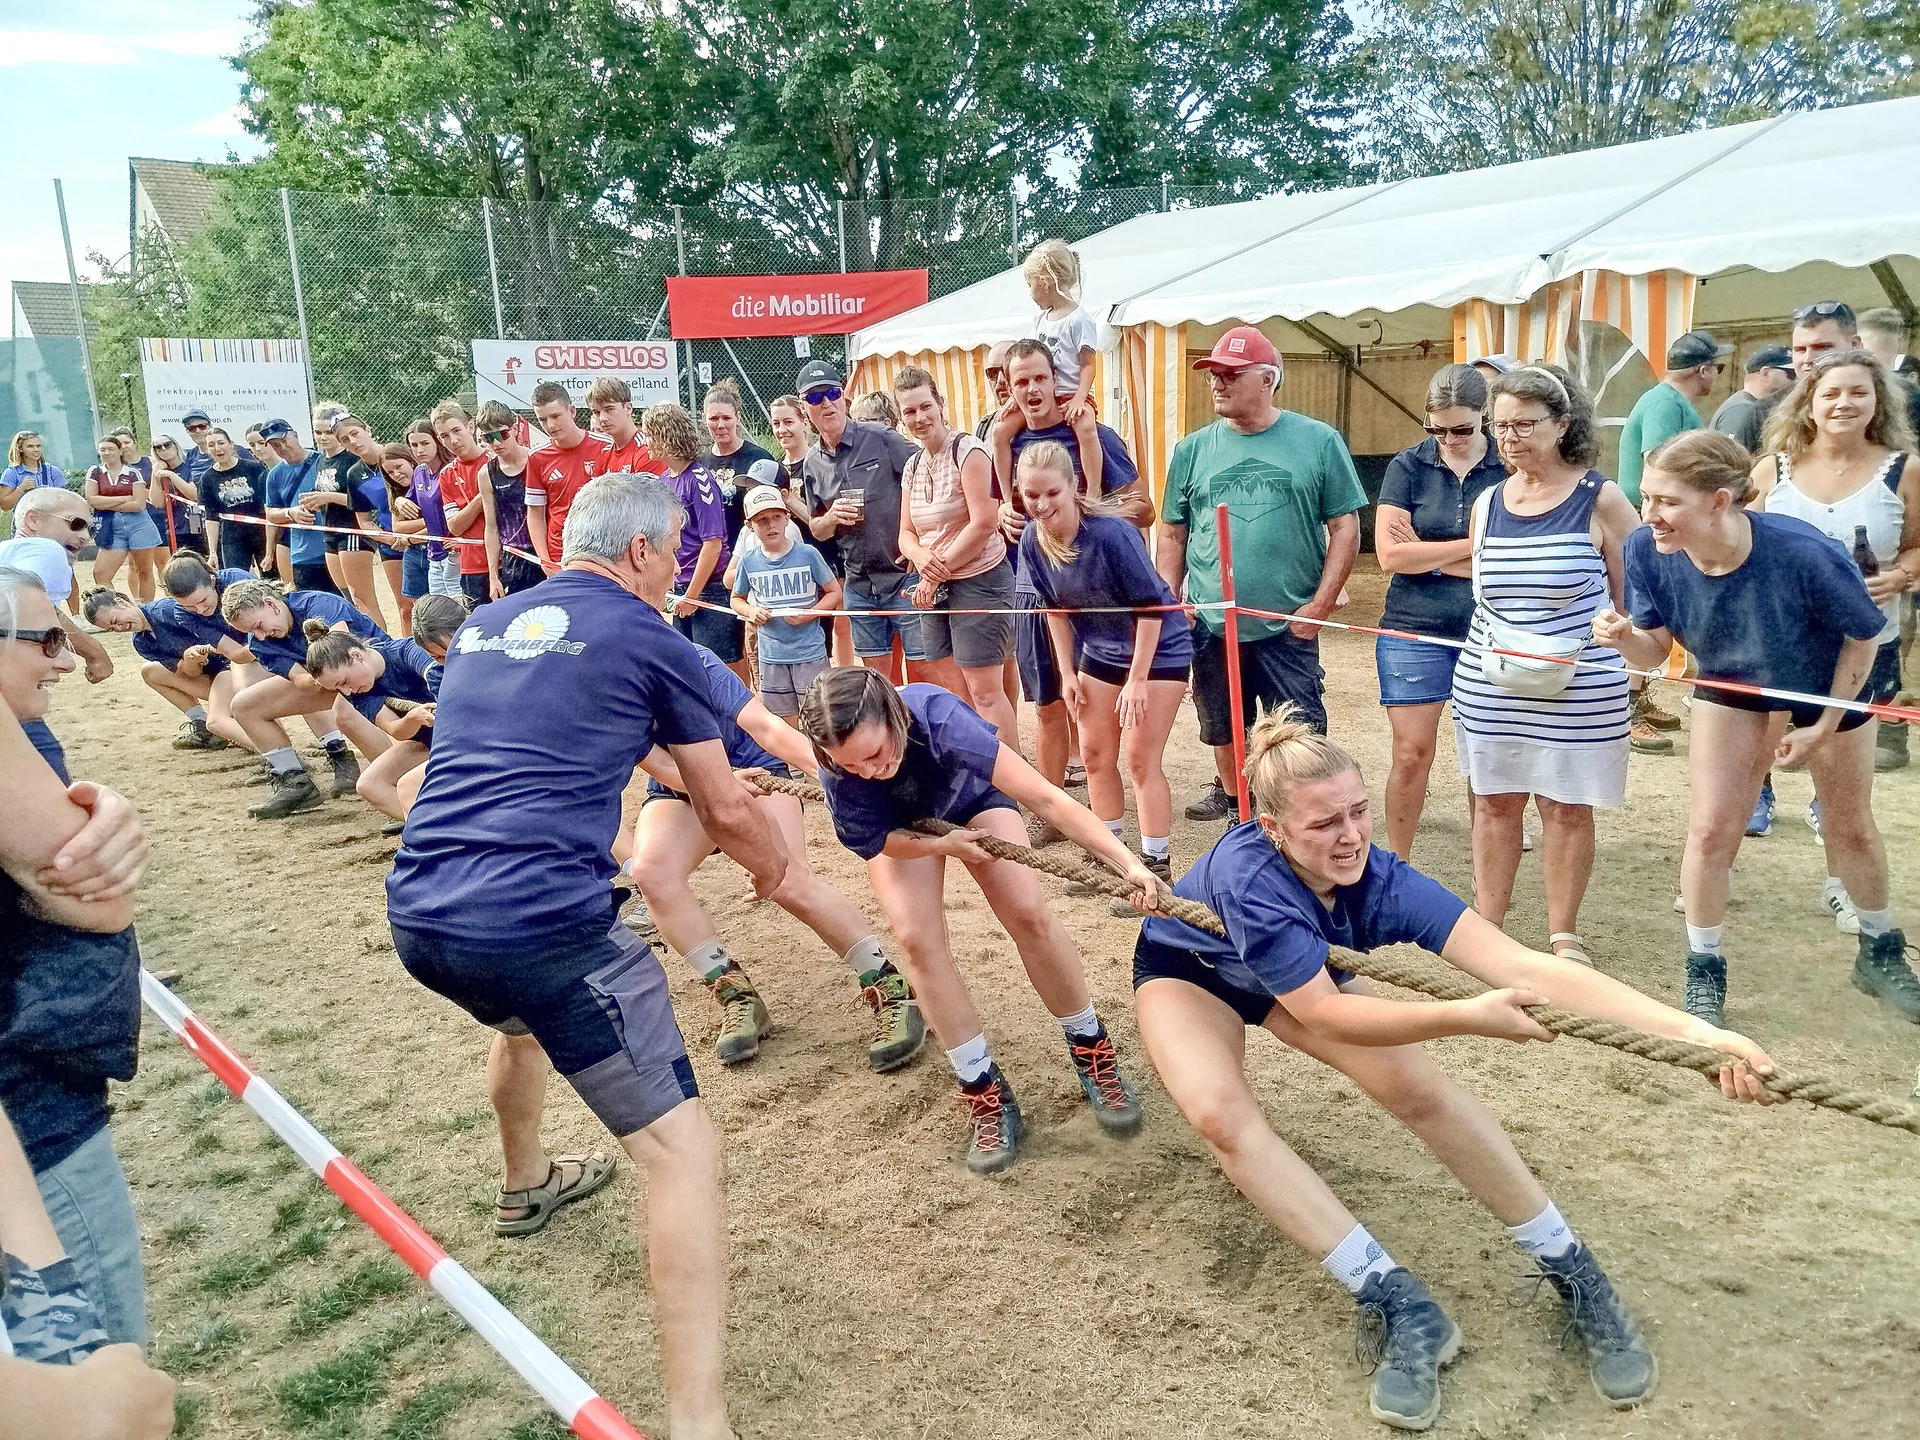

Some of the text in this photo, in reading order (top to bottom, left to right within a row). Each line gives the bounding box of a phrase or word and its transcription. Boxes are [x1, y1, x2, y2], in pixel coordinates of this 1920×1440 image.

[732, 293, 866, 318] die Mobiliar
[536, 346, 668, 369] SWISSLOS
[701, 366, 710, 379] 2
